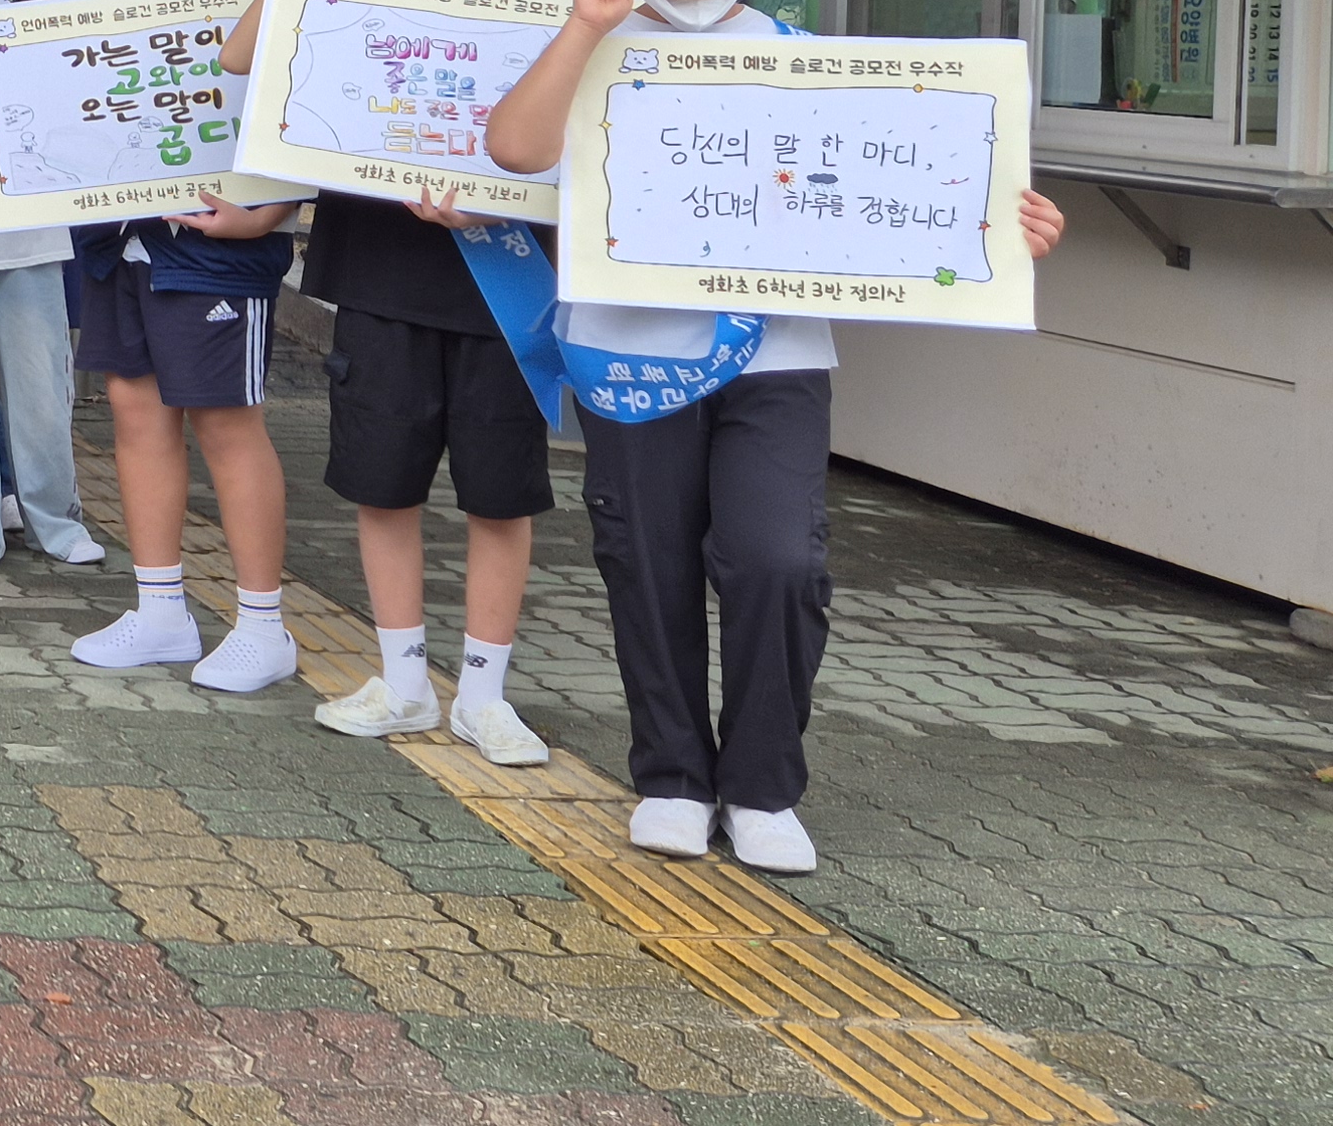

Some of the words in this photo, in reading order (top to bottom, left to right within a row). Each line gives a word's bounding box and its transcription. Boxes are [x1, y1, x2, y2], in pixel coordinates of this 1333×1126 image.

[21, 14, 73, 32] 언어폭력
[77, 10, 103, 25] 예방
[113, 4, 152, 22] 슬로건
[156, 0, 195, 16] 공모전
[514, 0, 559, 17] 공모전
[1270, 3, 1282, 19] 12
[61, 40, 140, 69] 가는
[149, 25, 224, 67] 말이
[1268, 24, 1280, 41] 13
[365, 33, 478, 62] 남에게
[1267, 47, 1280, 62] 14
[666, 54, 735, 71] 언어폭력
[743, 55, 779, 72] 예방
[789, 57, 842, 74] 슬로건
[849, 59, 902, 77] 공모전
[909, 60, 964, 78] 우수작
[1267, 68, 1279, 83] 15
[383, 61, 428, 96] 좋은
[434, 68, 477, 102] 말을
[81, 95, 143, 124] 오는
[153, 87, 223, 125] 말이
[368, 95, 417, 115] 나도
[660, 123, 749, 167] 당신의
[773, 133, 802, 165] 말
[820, 133, 845, 168] 한
[863, 140, 934, 172] 마디,
[73, 191, 112, 210] 영화초
[116, 186, 154, 204] 6학년
[157, 183, 181, 200] 4반
[354, 164, 397, 186] 영화초
[483, 184, 529, 202] 김보미
[681, 184, 758, 228] 상대의
[782, 188, 846, 221] 하루를
[857, 196, 959, 231] 정합니다
[698, 274, 749, 294] 영화초
[756, 277, 805, 298] 6학년
[811, 282, 843, 301] 3반
[849, 283, 906, 304] 정의산
